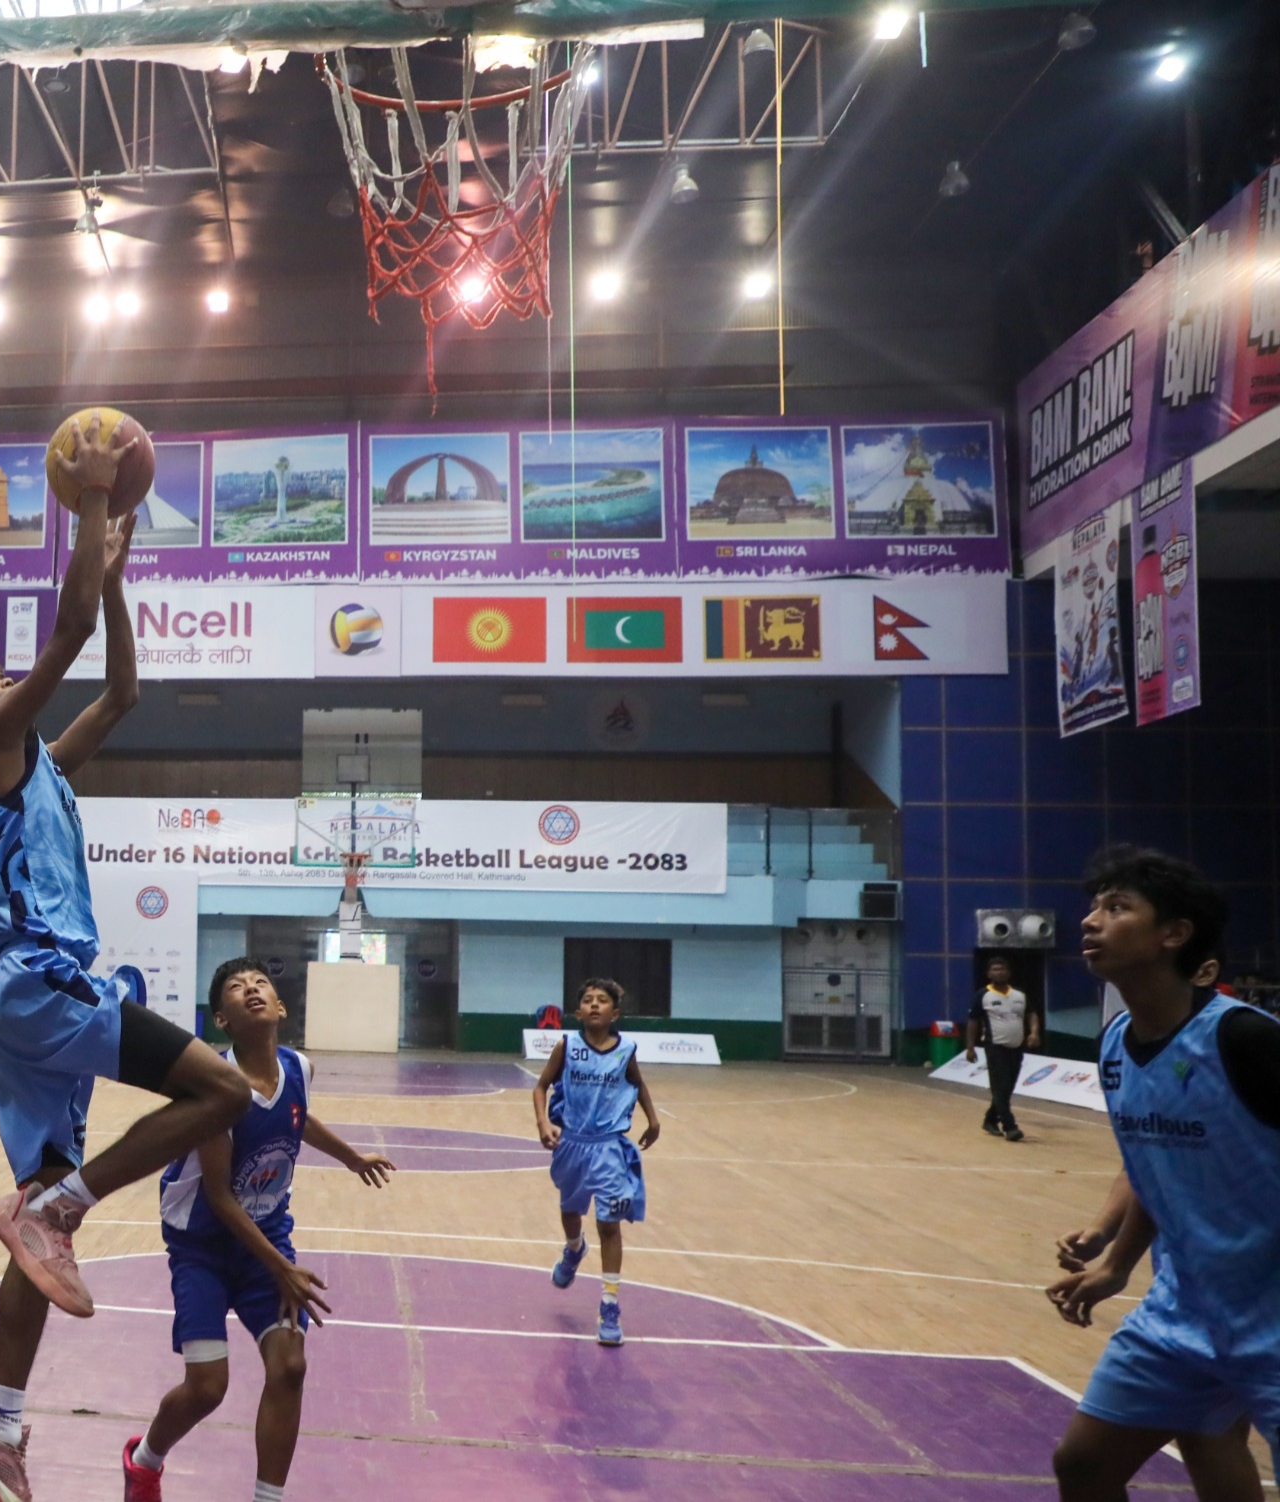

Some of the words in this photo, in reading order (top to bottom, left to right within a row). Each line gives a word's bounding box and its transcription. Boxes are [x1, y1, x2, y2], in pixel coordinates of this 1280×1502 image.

[1030, 381, 1073, 477] BAM
[1076, 331, 1134, 446] BAM!
[1029, 448, 1090, 509] HYDRATION
[1091, 419, 1131, 462] DRINK
[246, 550, 330, 563] KAZAKHSTAN
[403, 548, 497, 562] KYRGYZSTAN
[566, 547, 640, 560] MALDIVES
[735, 544, 757, 557] SRI
[758, 544, 807, 557] LANKA
[906, 543, 957, 556] NEPAL
[1161, 541, 1190, 570] NSBL
[128, 553, 158, 565] IRAN
[136, 602, 252, 639] Ncell
[208, 643, 252, 665] लागि
[88, 843, 157, 865] Under
[163, 846, 186, 864] 16
[193, 844, 296, 866] National
[382, 847, 517, 870] Basketball
[519, 849, 610, 873] League
[238, 868, 251, 877] 5th
[305, 869, 326, 878] 2083
[372, 870, 417, 881] Rangasala
[419, 871, 455, 880] Covered
[456, 871, 476, 881] Hall,
[477, 872, 526, 881] Kathmandu
[571, 1047, 589, 1061] 30
